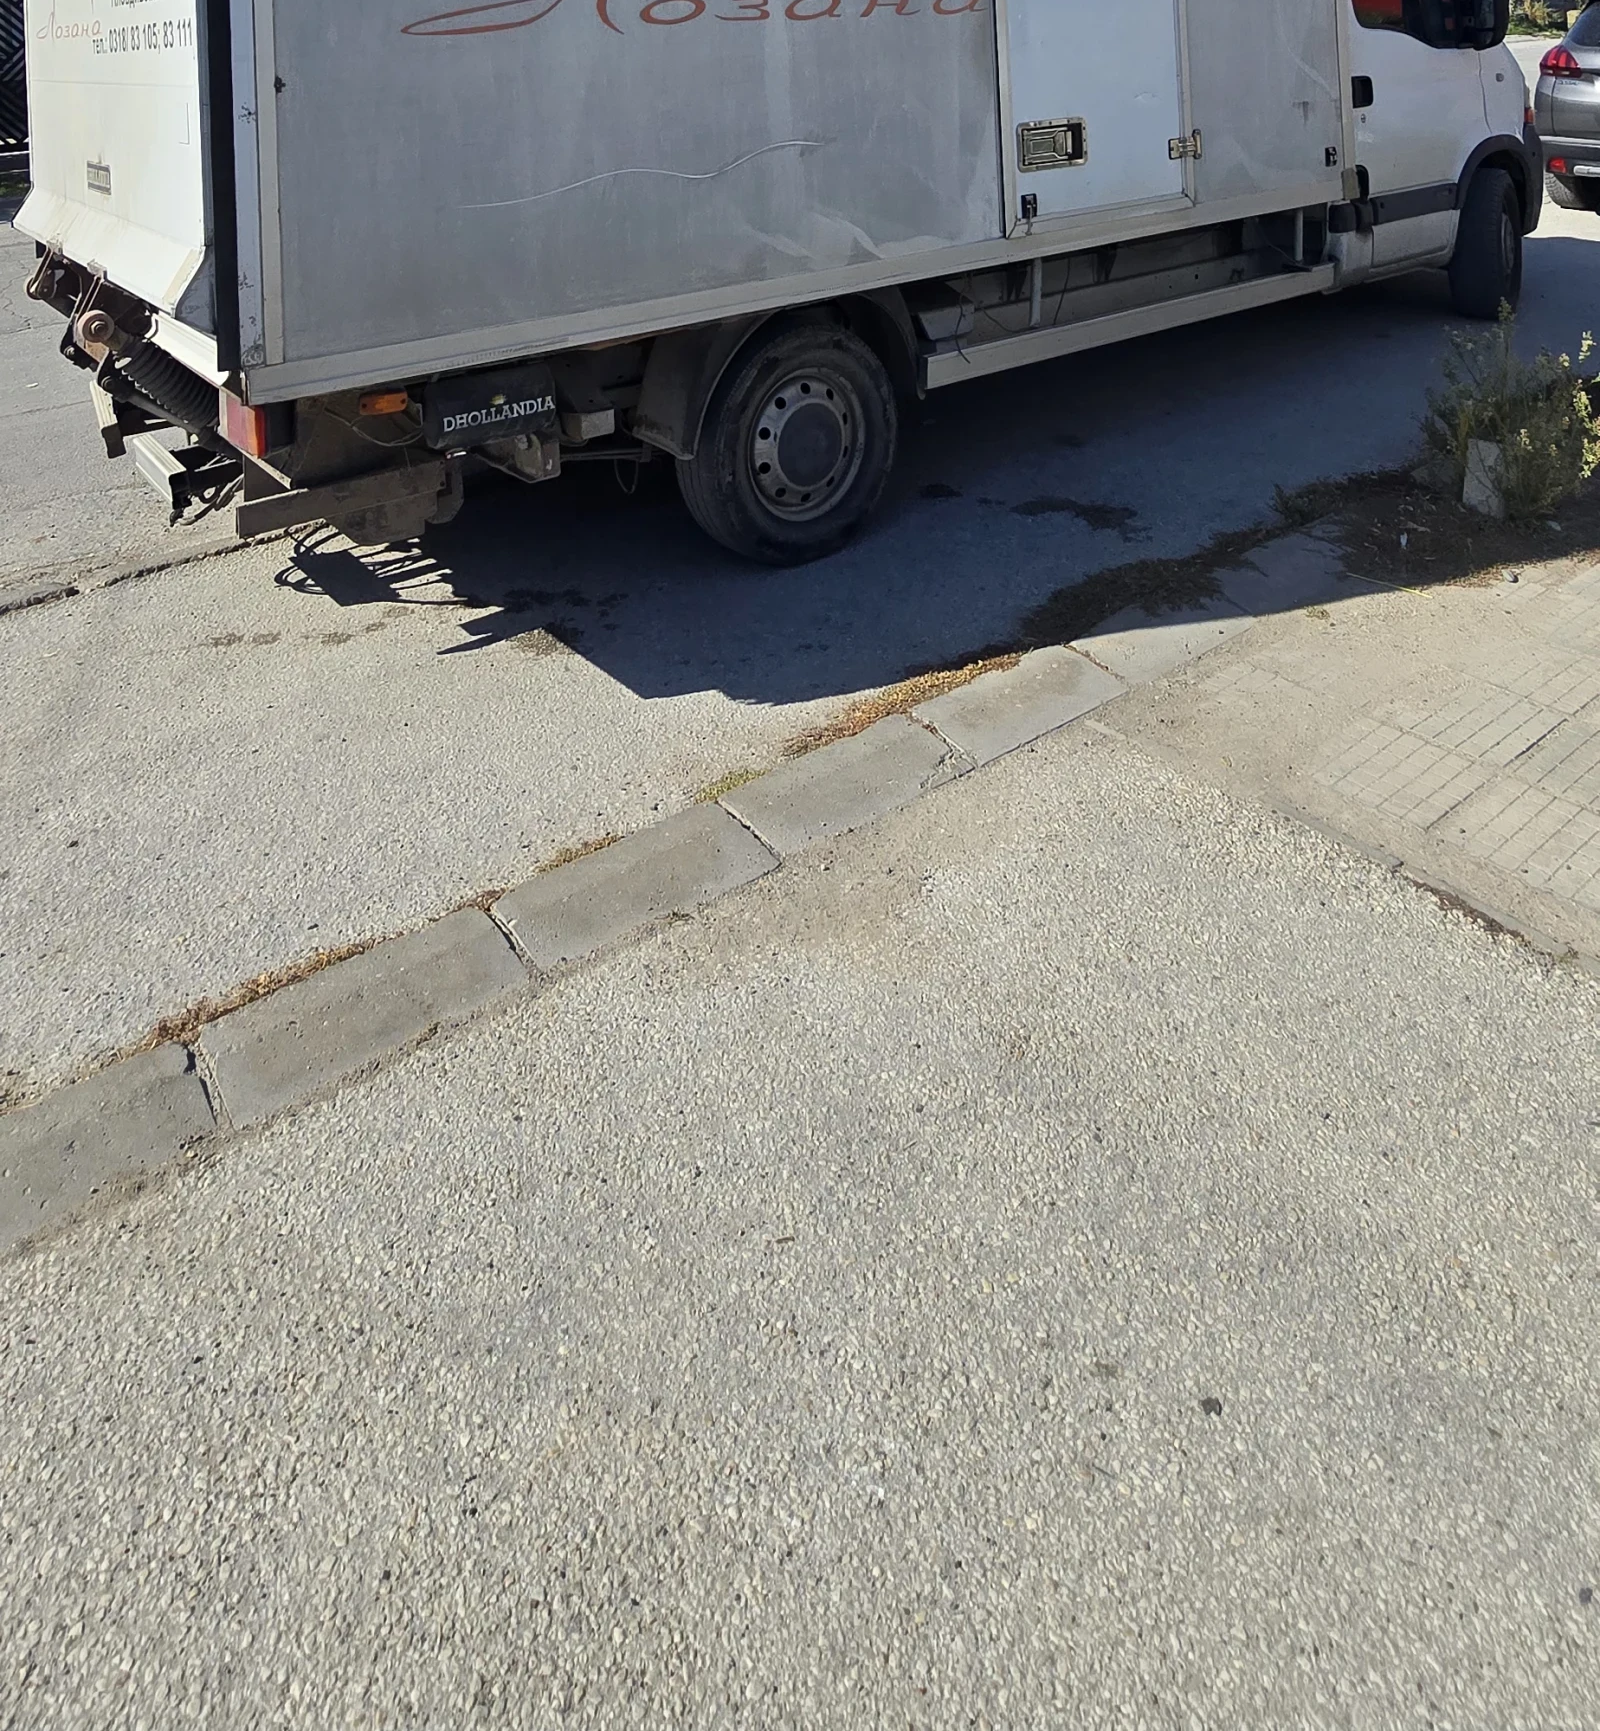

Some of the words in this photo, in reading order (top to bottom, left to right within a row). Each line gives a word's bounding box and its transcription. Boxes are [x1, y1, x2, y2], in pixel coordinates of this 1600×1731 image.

[131, 25, 140, 51] 83
[143, 22, 160, 54] 105;
[163, 20, 174, 48] 83
[177, 17, 192, 47] 111
[443, 395, 556, 433] DHOLLANDIA
